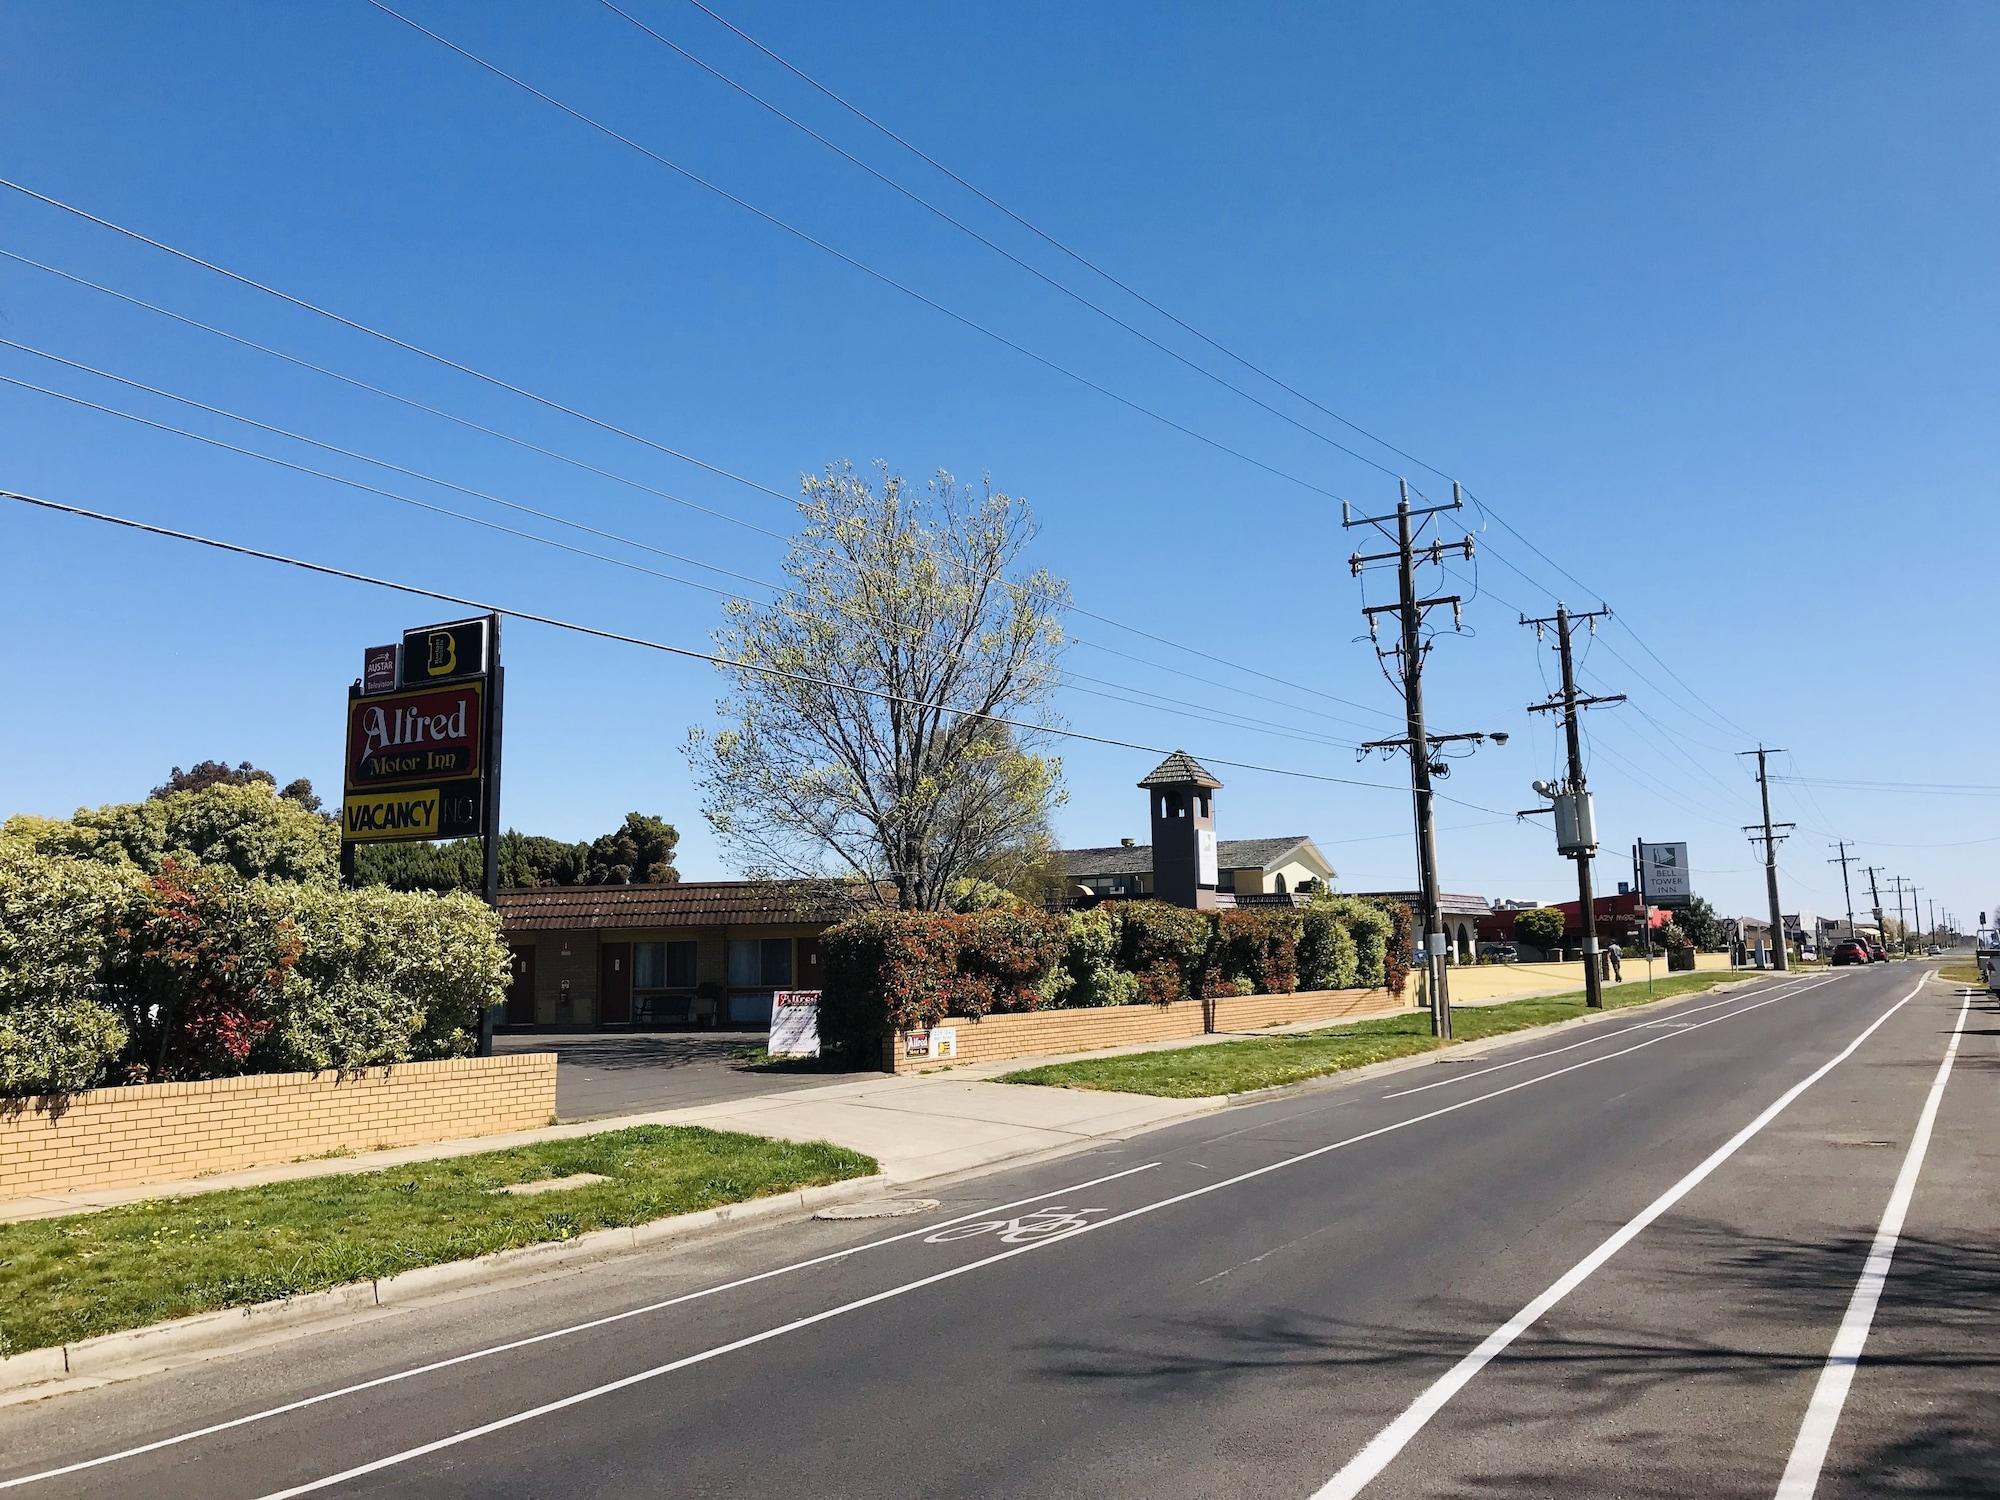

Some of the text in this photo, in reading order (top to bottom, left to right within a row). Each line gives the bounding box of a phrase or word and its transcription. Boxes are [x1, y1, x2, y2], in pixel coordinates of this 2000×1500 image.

[368, 661, 393, 673] AUSTAR
[367, 680, 393, 690] Television
[361, 700, 467, 766] Alfred
[370, 751, 456, 776] Motor Inn
[347, 799, 435, 832] VACANCY
[1595, 914, 1613, 922] LAZY
